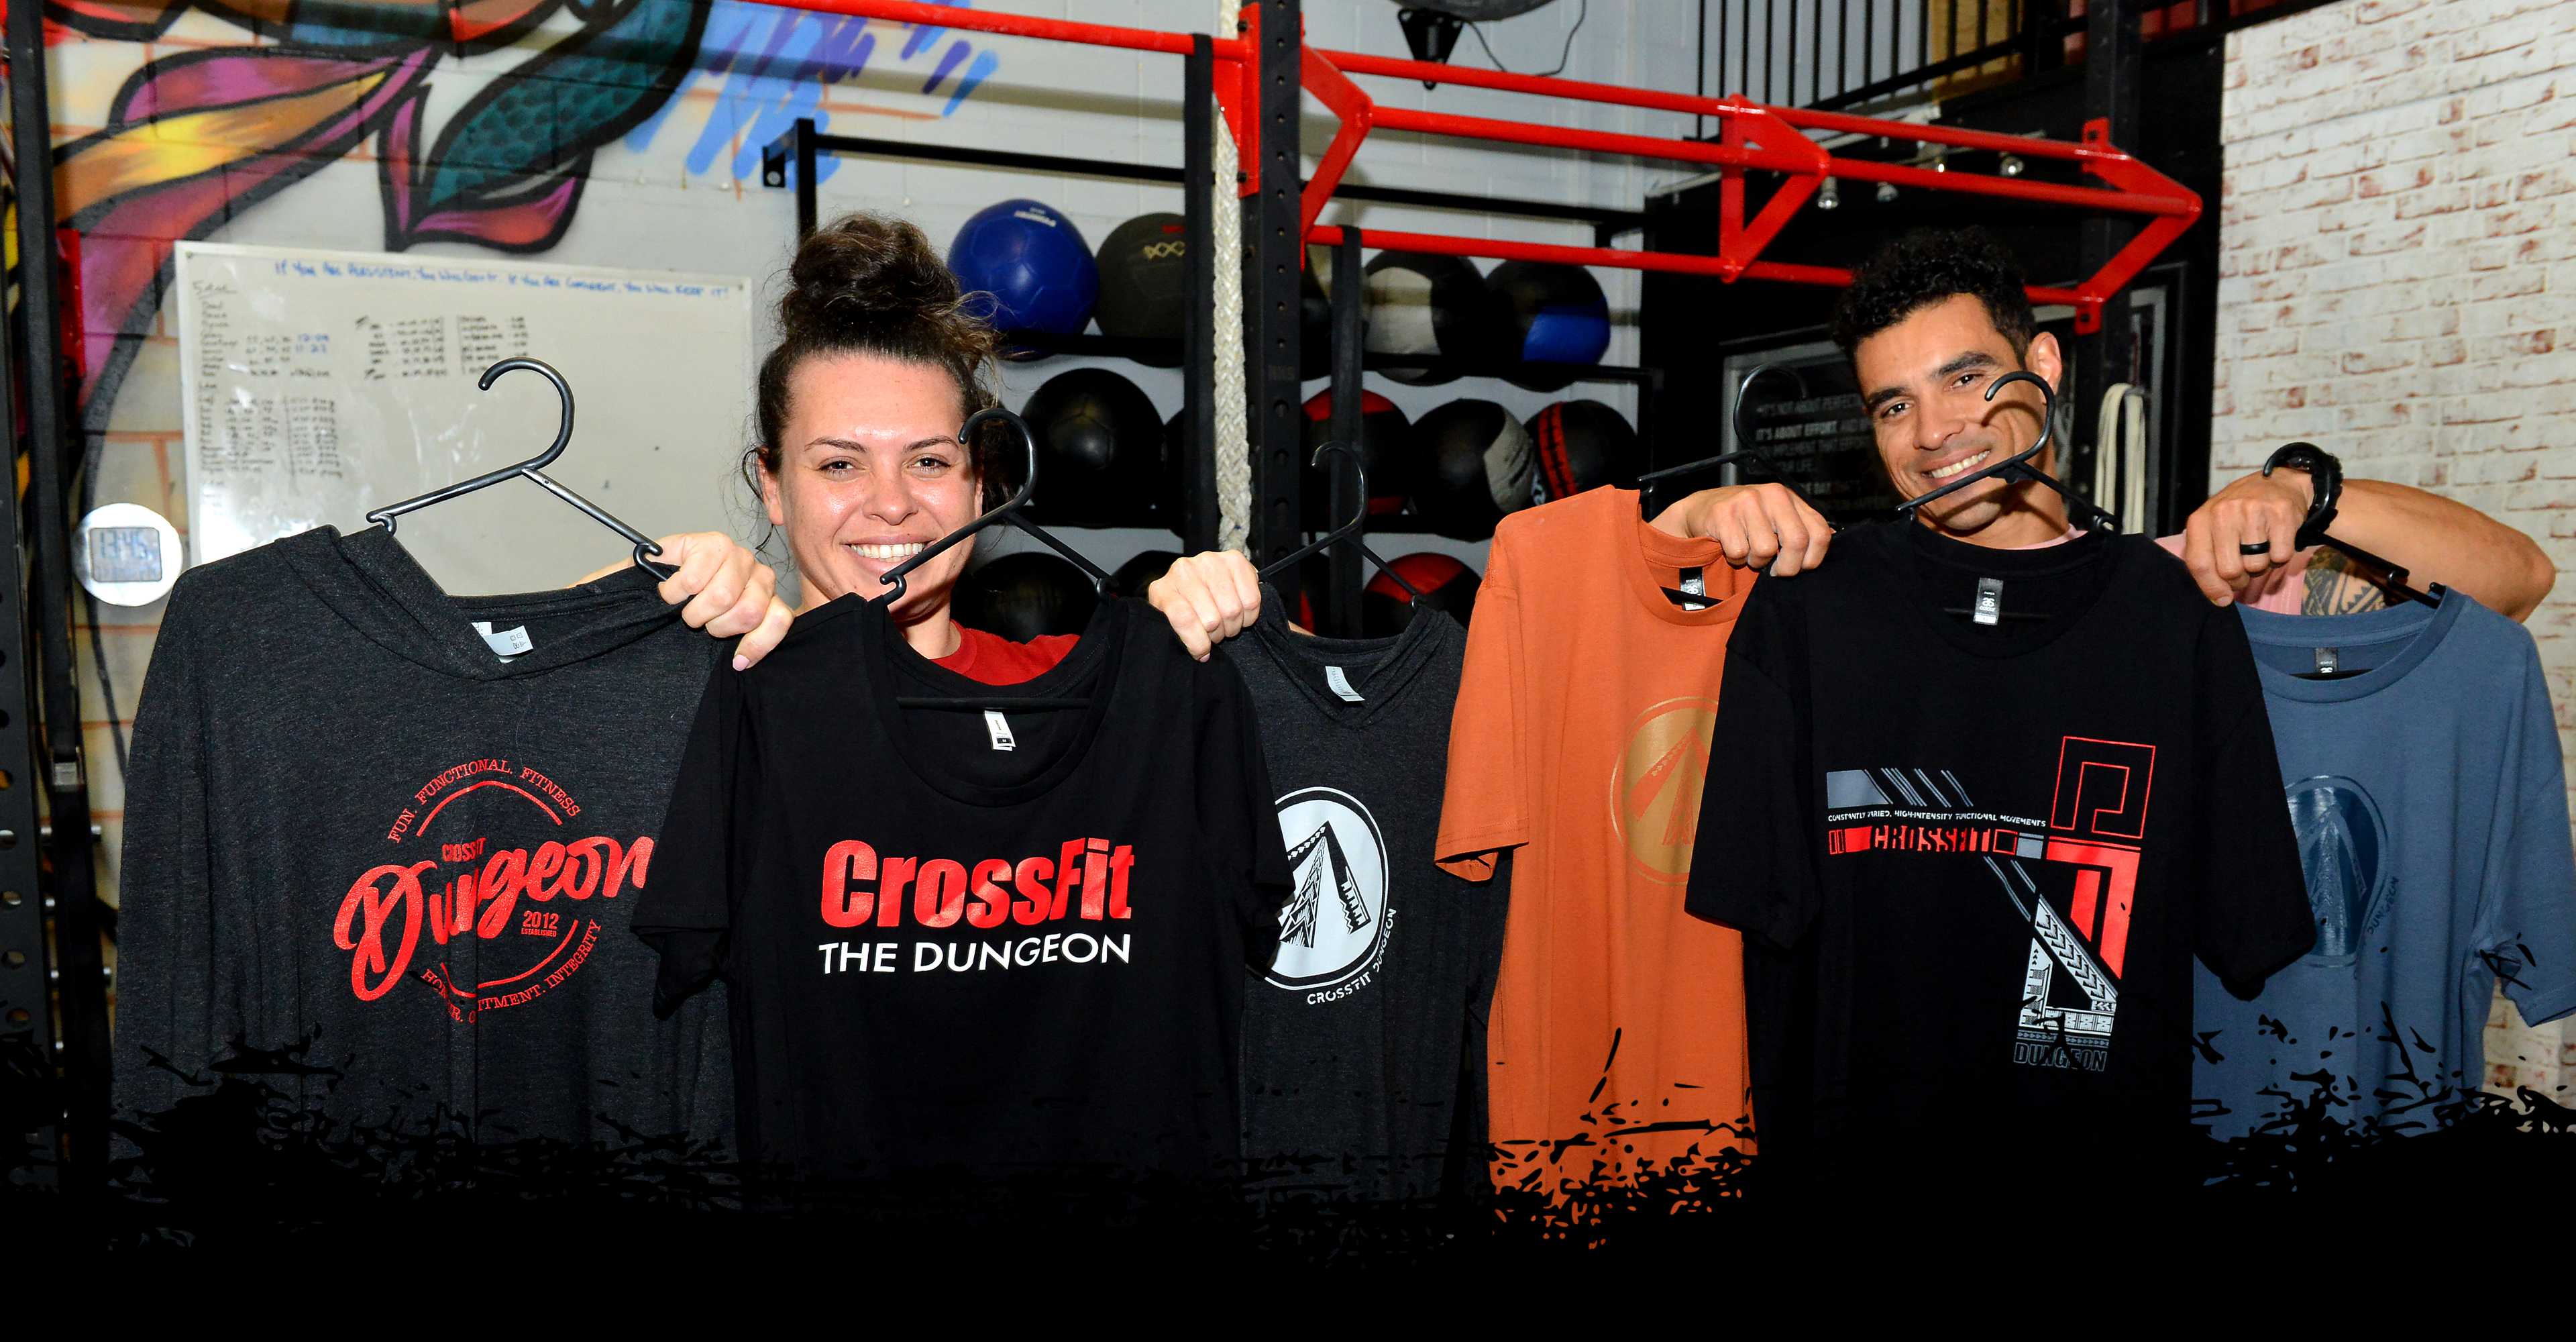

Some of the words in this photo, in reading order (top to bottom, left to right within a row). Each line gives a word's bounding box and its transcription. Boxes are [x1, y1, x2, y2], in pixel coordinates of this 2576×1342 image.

[388, 808, 418, 843] FUN.
[414, 758, 512, 805] FUNCTIONAL.
[520, 766, 582, 818] FITNESS
[1828, 811, 1866, 822] CONSTANTLY
[1955, 813, 1997, 821] FUNCTIONAL
[2000, 815, 2047, 827] MOVEMENTS
[821, 837, 1135, 928] CrossFit
[521, 928, 557, 937] ESTABLISHED
[523, 910, 559, 930] 2012
[547, 919, 602, 989] INTEGRITY
[818, 941, 899, 975] THE
[914, 932, 1131, 973] DUNGEON
[1307, 972, 1372, 1006] CROSSFIT
[1373, 908, 1397, 973] DUNGEON
